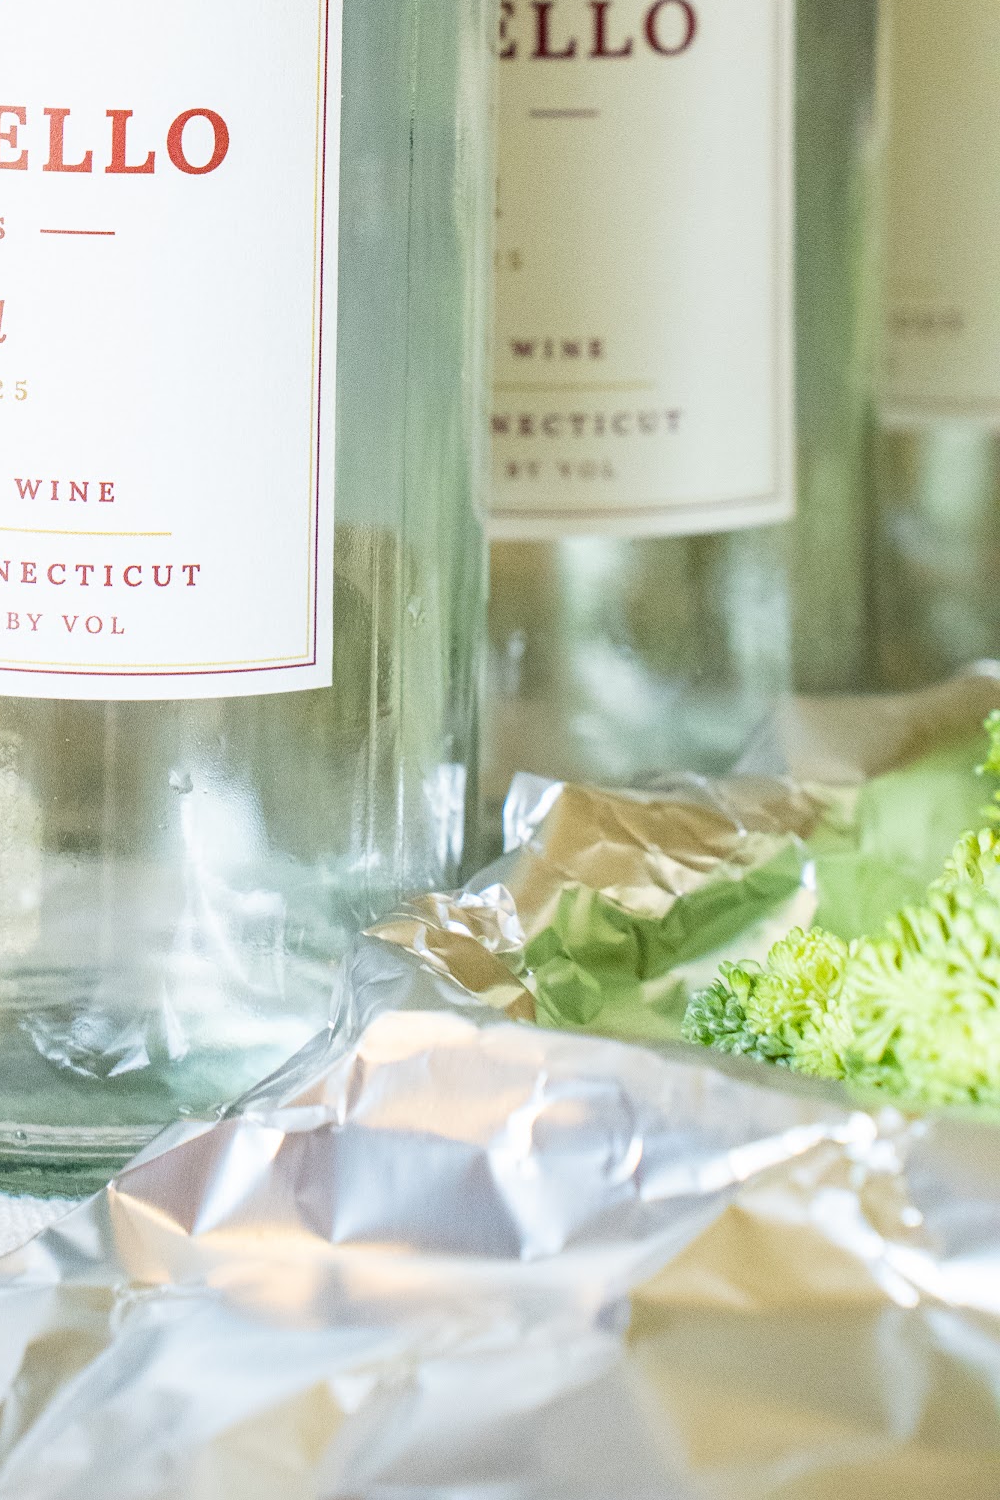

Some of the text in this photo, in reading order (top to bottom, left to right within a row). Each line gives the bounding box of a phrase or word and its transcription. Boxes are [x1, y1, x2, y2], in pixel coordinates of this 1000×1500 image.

[13, 477, 117, 504] WINE
[6, 611, 44, 632] BY
[62, 615, 126, 636] VOL
